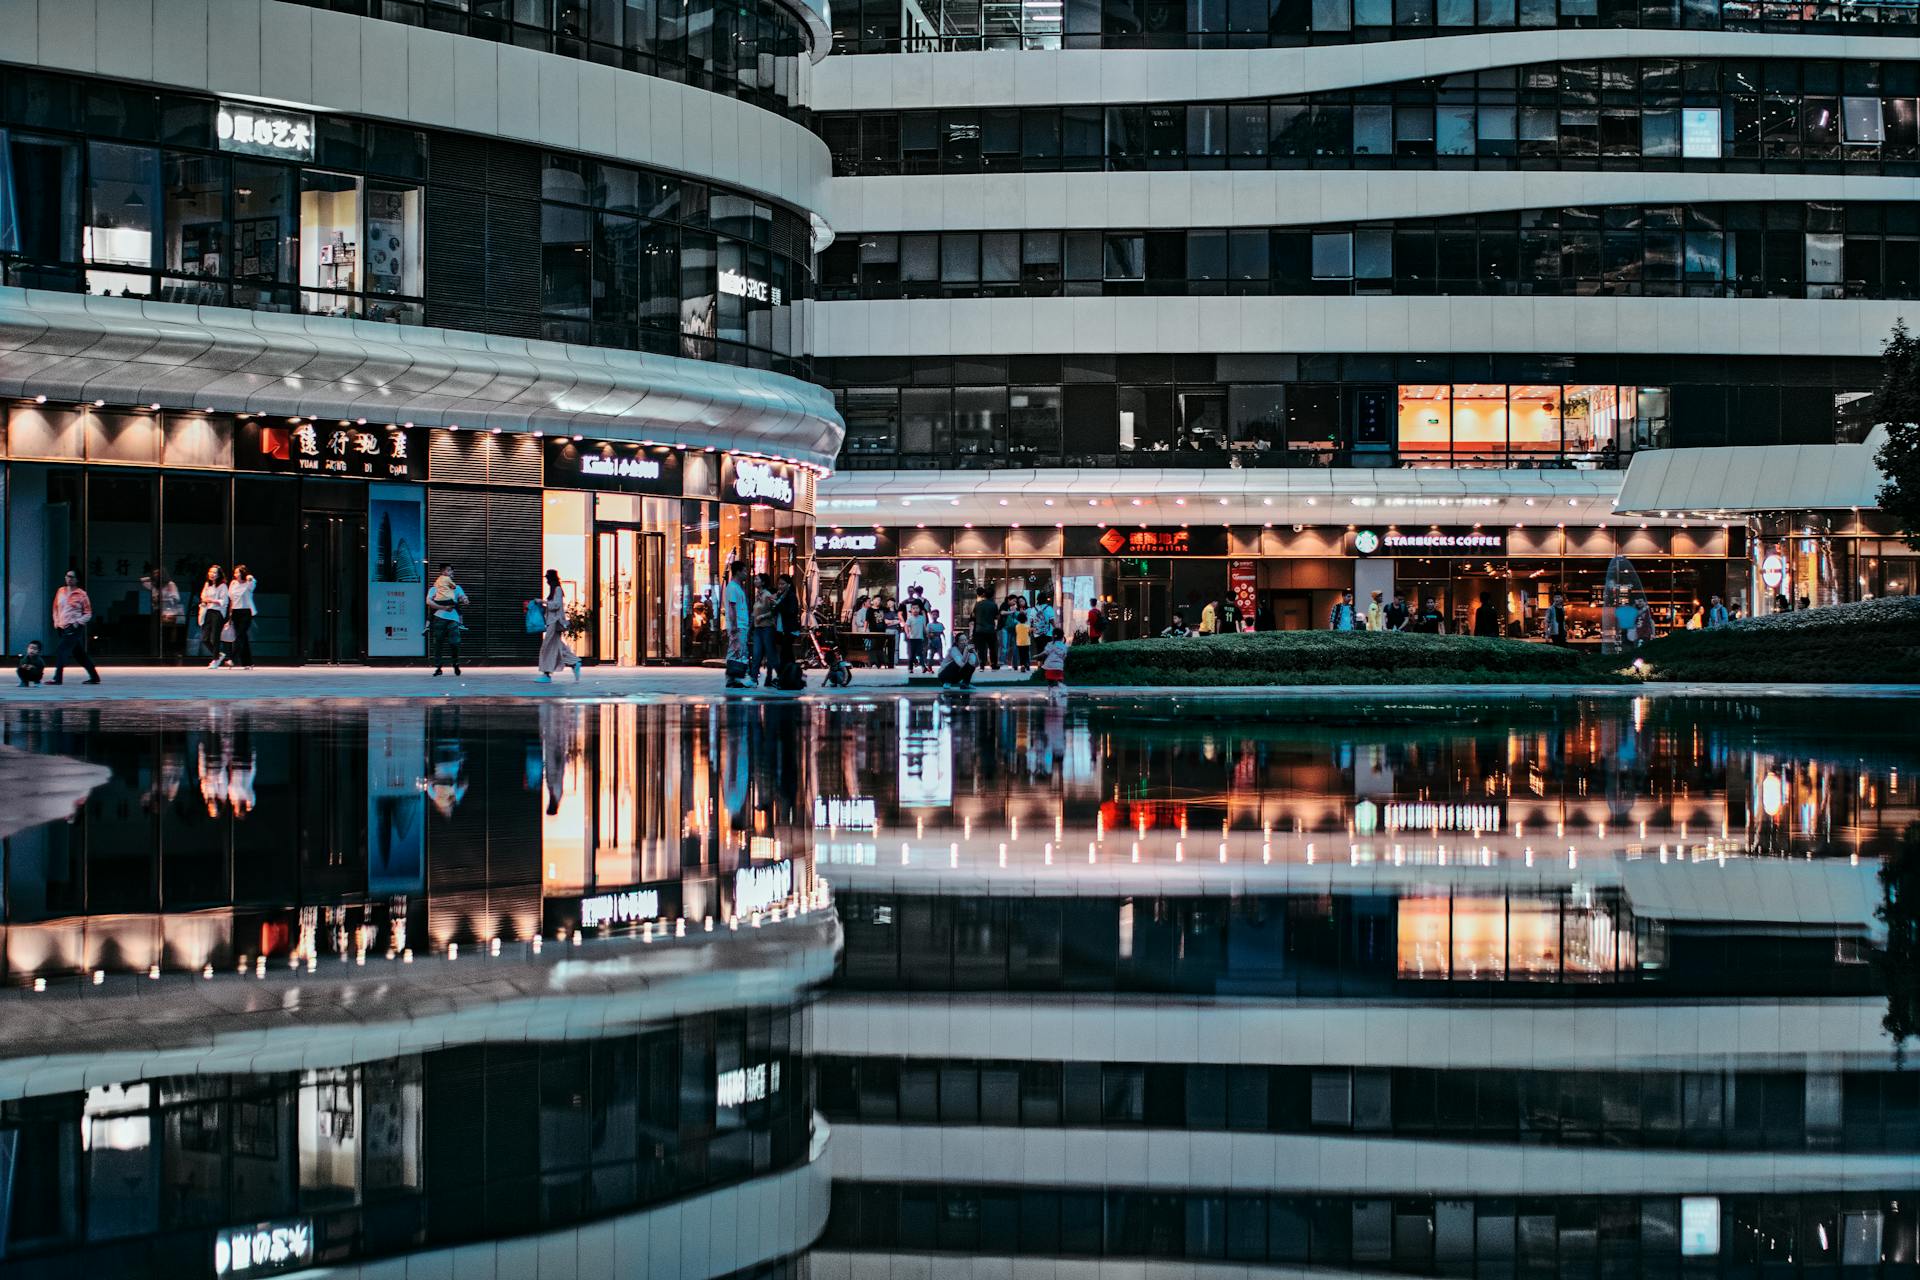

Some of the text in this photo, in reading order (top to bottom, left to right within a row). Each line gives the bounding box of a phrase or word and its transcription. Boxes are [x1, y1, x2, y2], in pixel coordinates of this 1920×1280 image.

[747, 278, 768, 302] SPACE
[300, 459, 319, 470] YUAN
[364, 462, 373, 473] DI
[389, 463, 408, 476] CHAN
[1384, 536, 1501, 547] STARBUCKS COFFEE
